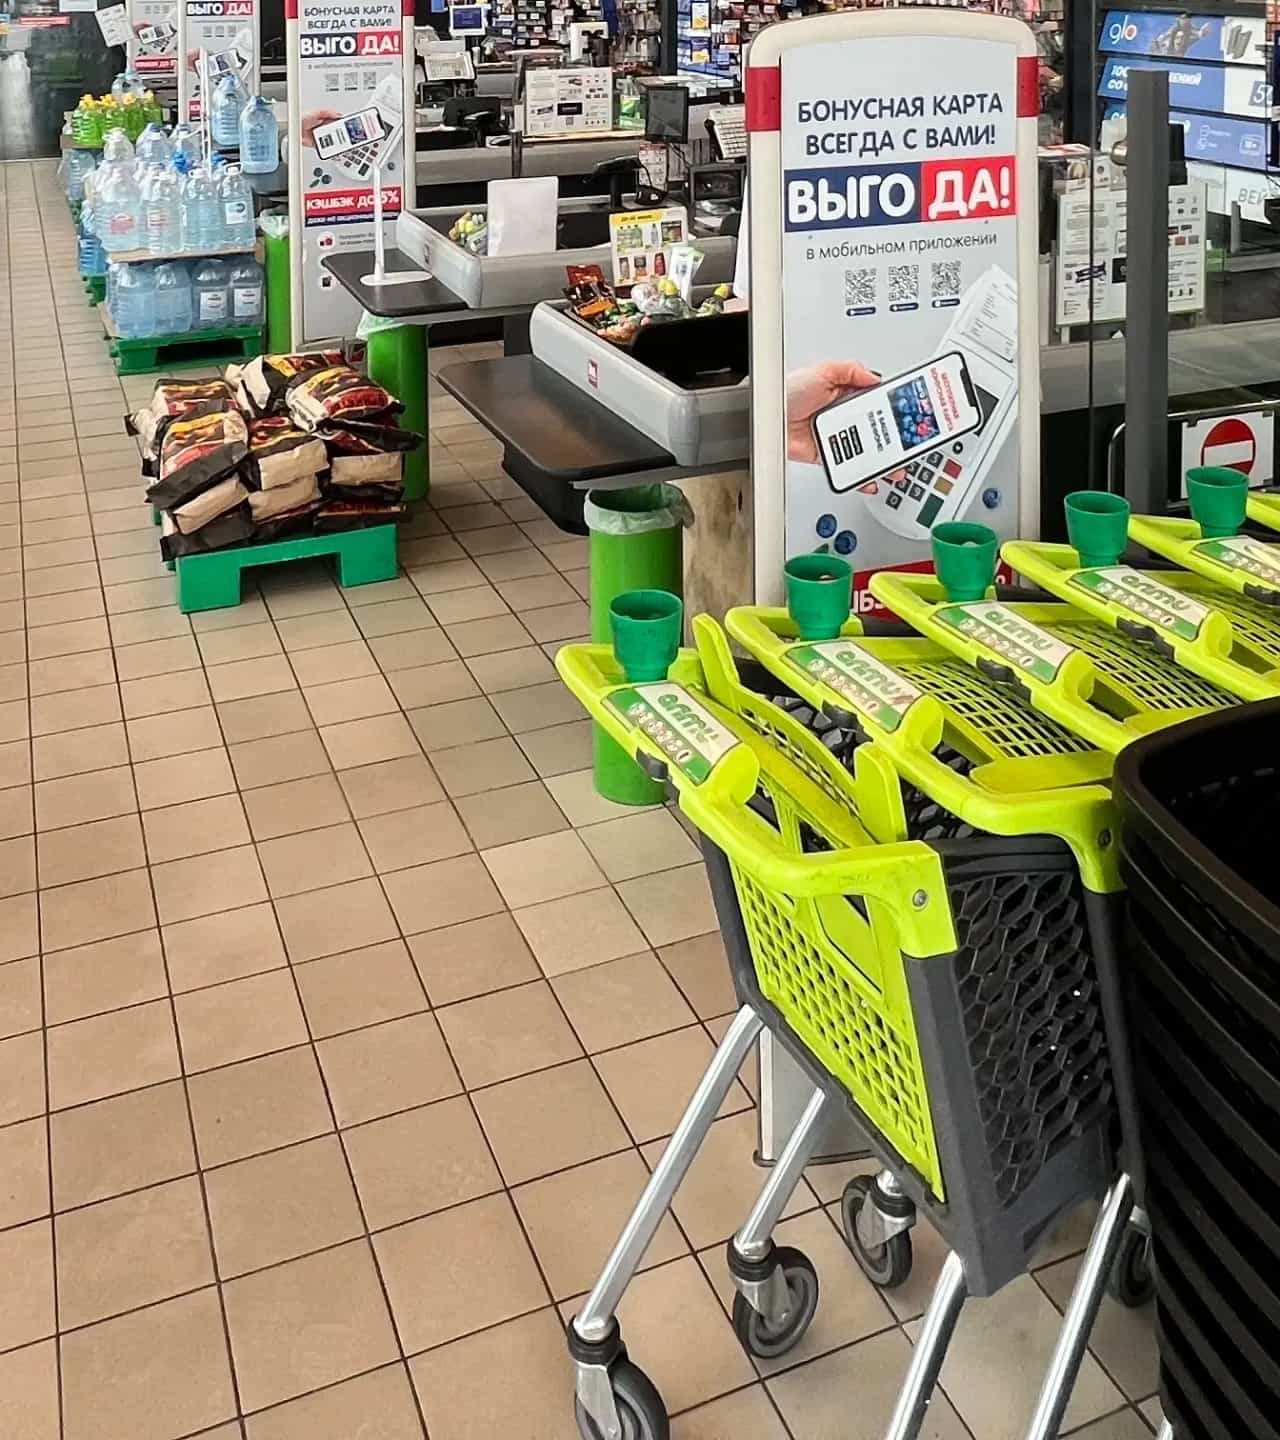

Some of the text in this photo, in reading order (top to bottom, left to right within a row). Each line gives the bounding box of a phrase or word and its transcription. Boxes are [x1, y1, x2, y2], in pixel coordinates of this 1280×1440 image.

[304, 5, 395, 17] БОНУСНАЯ КАРТА
[308, 20, 346, 30] ВСЕГДА
[350, 19, 356, 27] С
[1109, 15, 1137, 44] glo
[301, 35, 400, 55] ВЫГО ДА!
[798, 92, 1003, 124] БОНУСНАЯ КАРТА
[805, 124, 996, 157] ВСЕГДА С ВАМИ!
[306, 196, 355, 211] КЭШБЭК
[787, 167, 1011, 224] ВЫГО ДА!
[806, 231, 997, 260] в мобильном приложении
